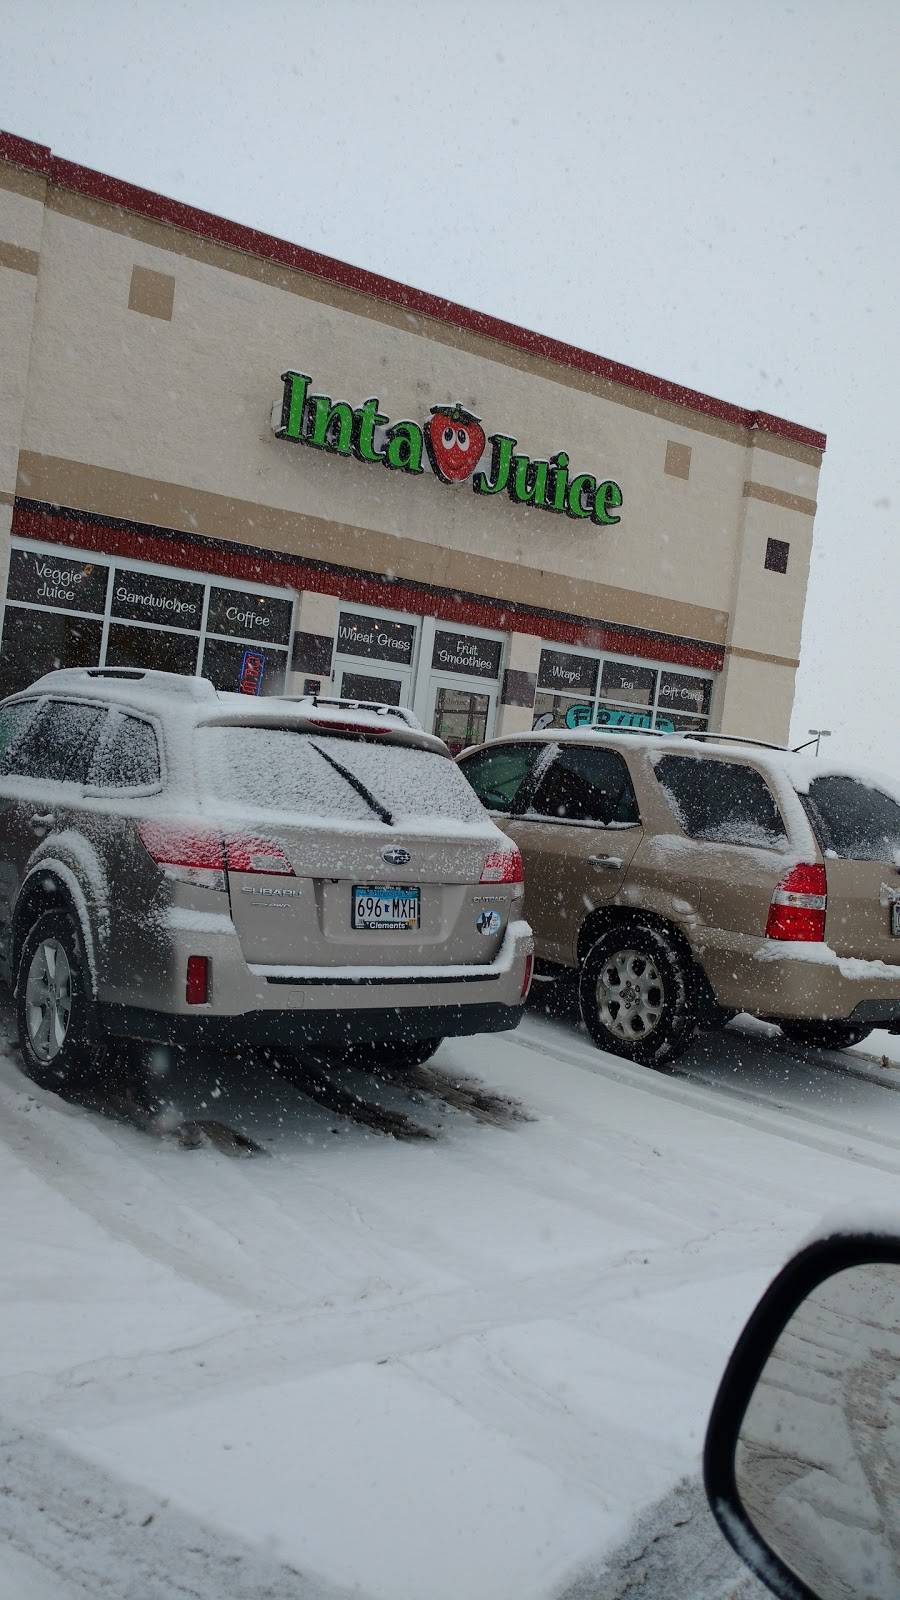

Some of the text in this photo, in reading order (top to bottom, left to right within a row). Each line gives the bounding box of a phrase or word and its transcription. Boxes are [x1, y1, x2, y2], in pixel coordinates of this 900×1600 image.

[275, 369, 624, 526] Inta Juice
[34, 560, 83, 586] Veggie
[37, 586, 75, 601] Juice
[116, 587, 197, 615] Sandwiches
[226, 606, 271, 628] Coffee
[339, 625, 411, 651] Wheat Grass
[456, 640, 479, 656] Fruit
[439, 650, 492, 670] Smoothies
[552, 665, 581, 684] Wraps
[620, 677, 634, 690] Tea
[662, 685, 704, 703] Gift Cards
[241, 886, 303, 897] SUBARU
[357, 897, 416, 918] 696 MXH
[369, 921, 406, 929] Clements
